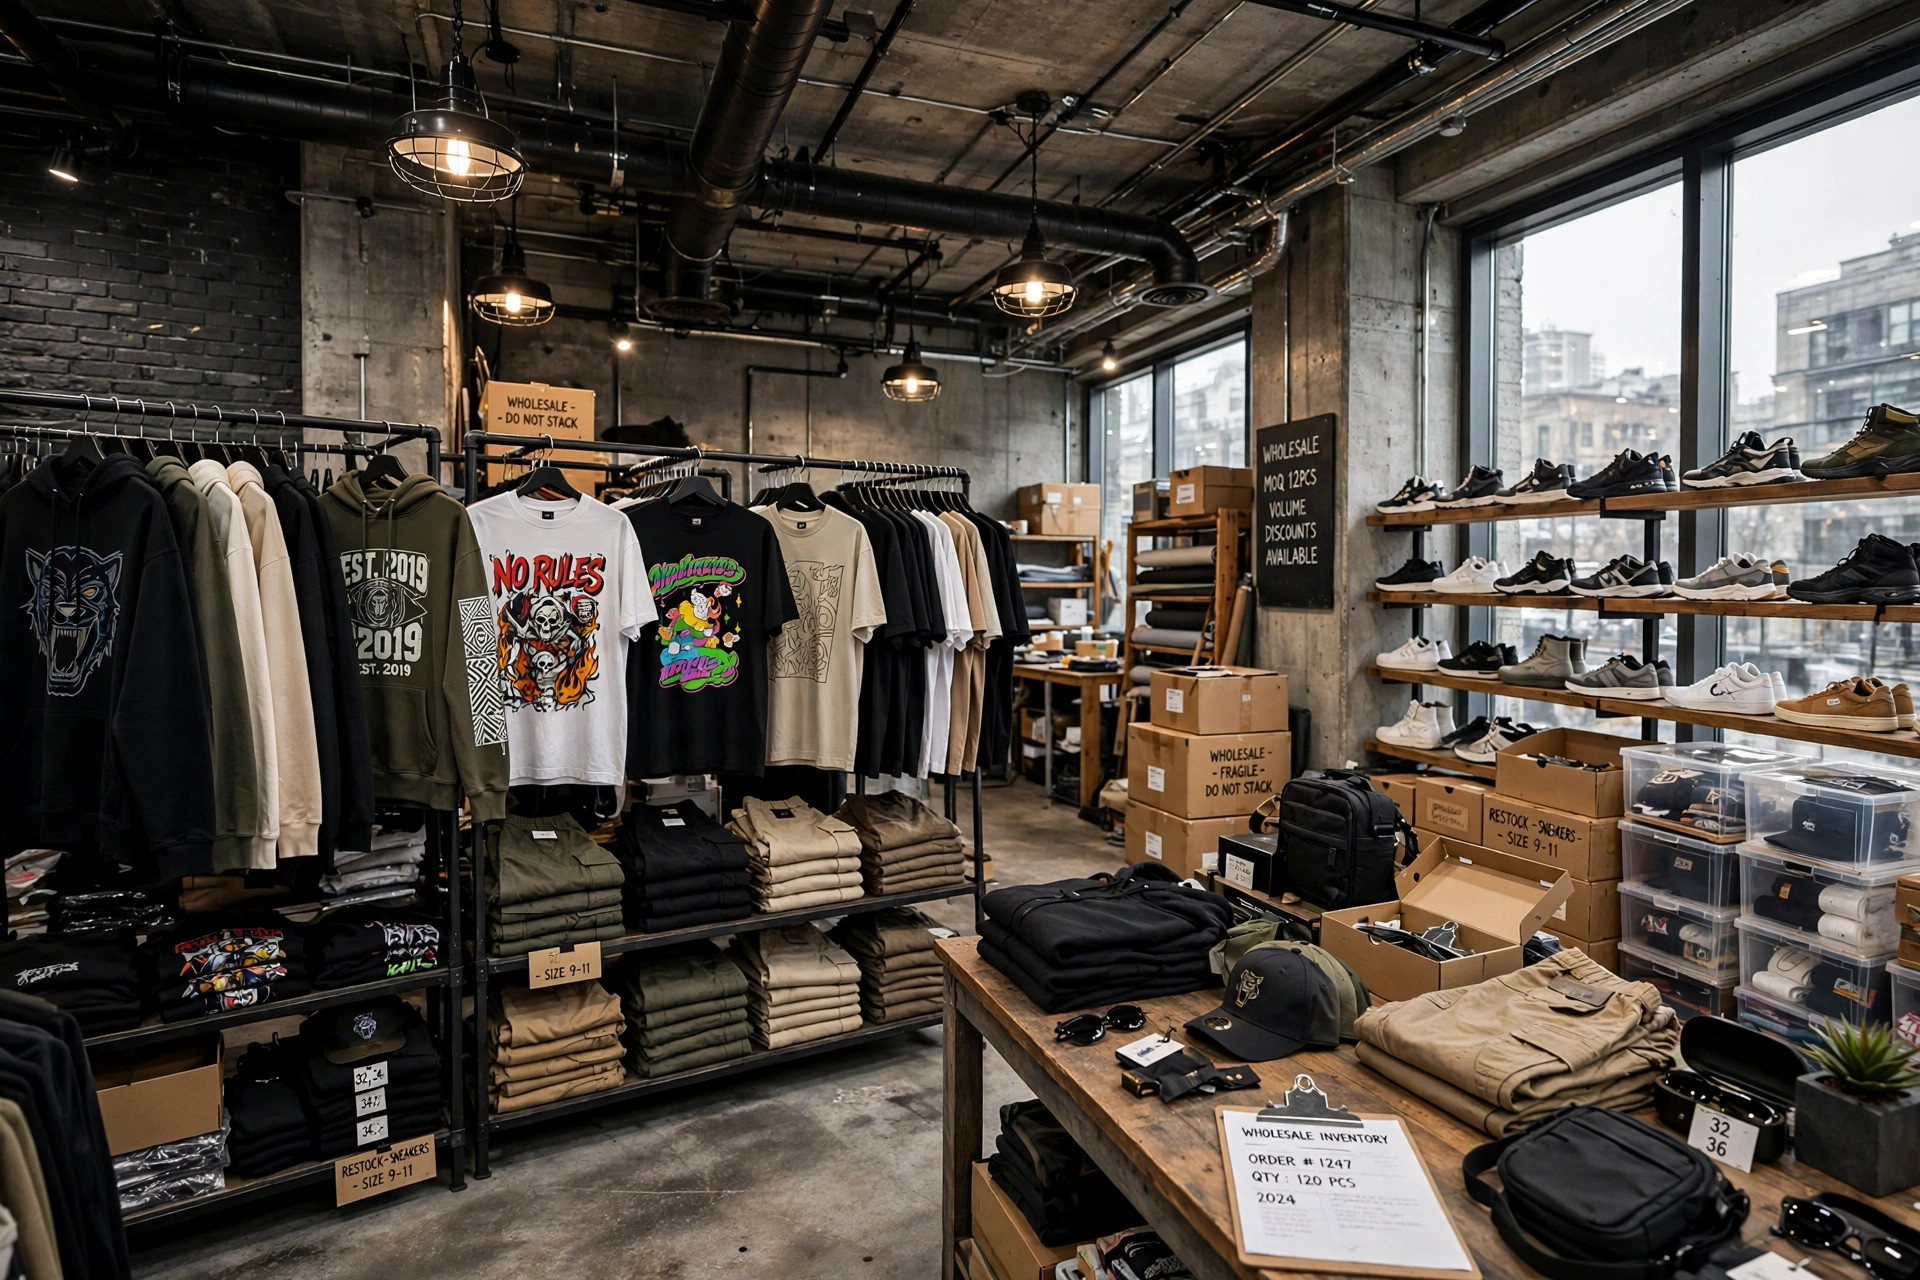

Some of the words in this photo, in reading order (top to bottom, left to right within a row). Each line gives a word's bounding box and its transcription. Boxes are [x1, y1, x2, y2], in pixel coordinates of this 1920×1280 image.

[507, 395, 569, 413] WHOLESALE
[505, 411, 520, 425] DO
[523, 414, 544, 427] NOT
[547, 415, 579, 430] STACK
[1262, 435, 1320, 464] WHOLESALE
[1263, 473, 1285, 493] MOQ
[1288, 468, 1318, 490] 12PCS
[1269, 499, 1307, 519] VOLUME
[1265, 522, 1317, 543] DISCOUNTS
[1265, 546, 1318, 566] AVAILABLE
[386, 552, 429, 594] 2019
[492, 552, 530, 600] NO
[533, 554, 606, 598] RULES
[357, 622, 423, 663] 2019
[382, 663, 412, 677] 2019
[1210, 746, 1266, 763] WHOLESALE
[1220, 763, 1258, 780] FRAGILE
[1205, 783, 1219, 797] DO
[1221, 782, 1241, 796] NOT
[1243, 779, 1273, 795] STACK
[1489, 807, 1529, 832] RESTOCK
[1507, 830, 1529, 849] SIZE
[1533, 838, 1558, 858] 9-11
[544, 966, 566, 981] SIZE
[569, 962, 591, 977] 9-11
[1241, 1127, 1315, 1141] WHOLESALE
[1320, 1133, 1389, 1144] INVENTORY
[1710, 1117, 1730, 1138] 32
[1706, 1136, 1727, 1157] 36
[1248, 1153, 1296, 1167] ORDER
[1319, 1158, 1352, 1170] 1247
[362, 1172, 385, 1190] SIZE
[388, 1163, 413, 1182] 9-11
[1251, 1171, 1280, 1183] QTY
[1297, 1174, 1323, 1187] 120
[1329, 1176, 1357, 1189] PCS
[1256, 1192, 1297, 1205] 2024
